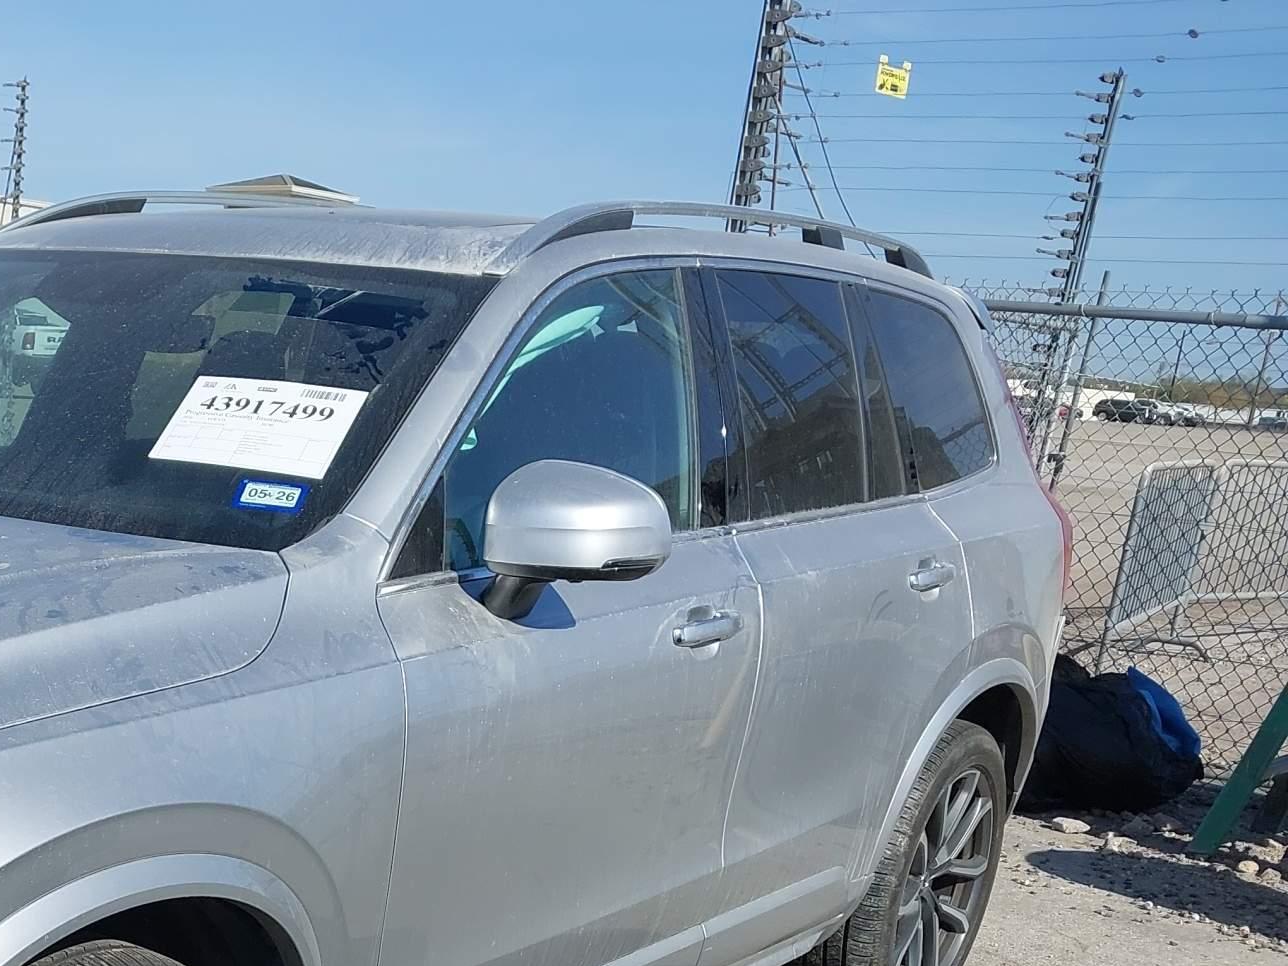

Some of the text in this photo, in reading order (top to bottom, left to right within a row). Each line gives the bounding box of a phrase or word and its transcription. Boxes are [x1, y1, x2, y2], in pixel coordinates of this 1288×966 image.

[199, 395, 335, 422] 43917499
[247, 487, 297, 502] 05 26
